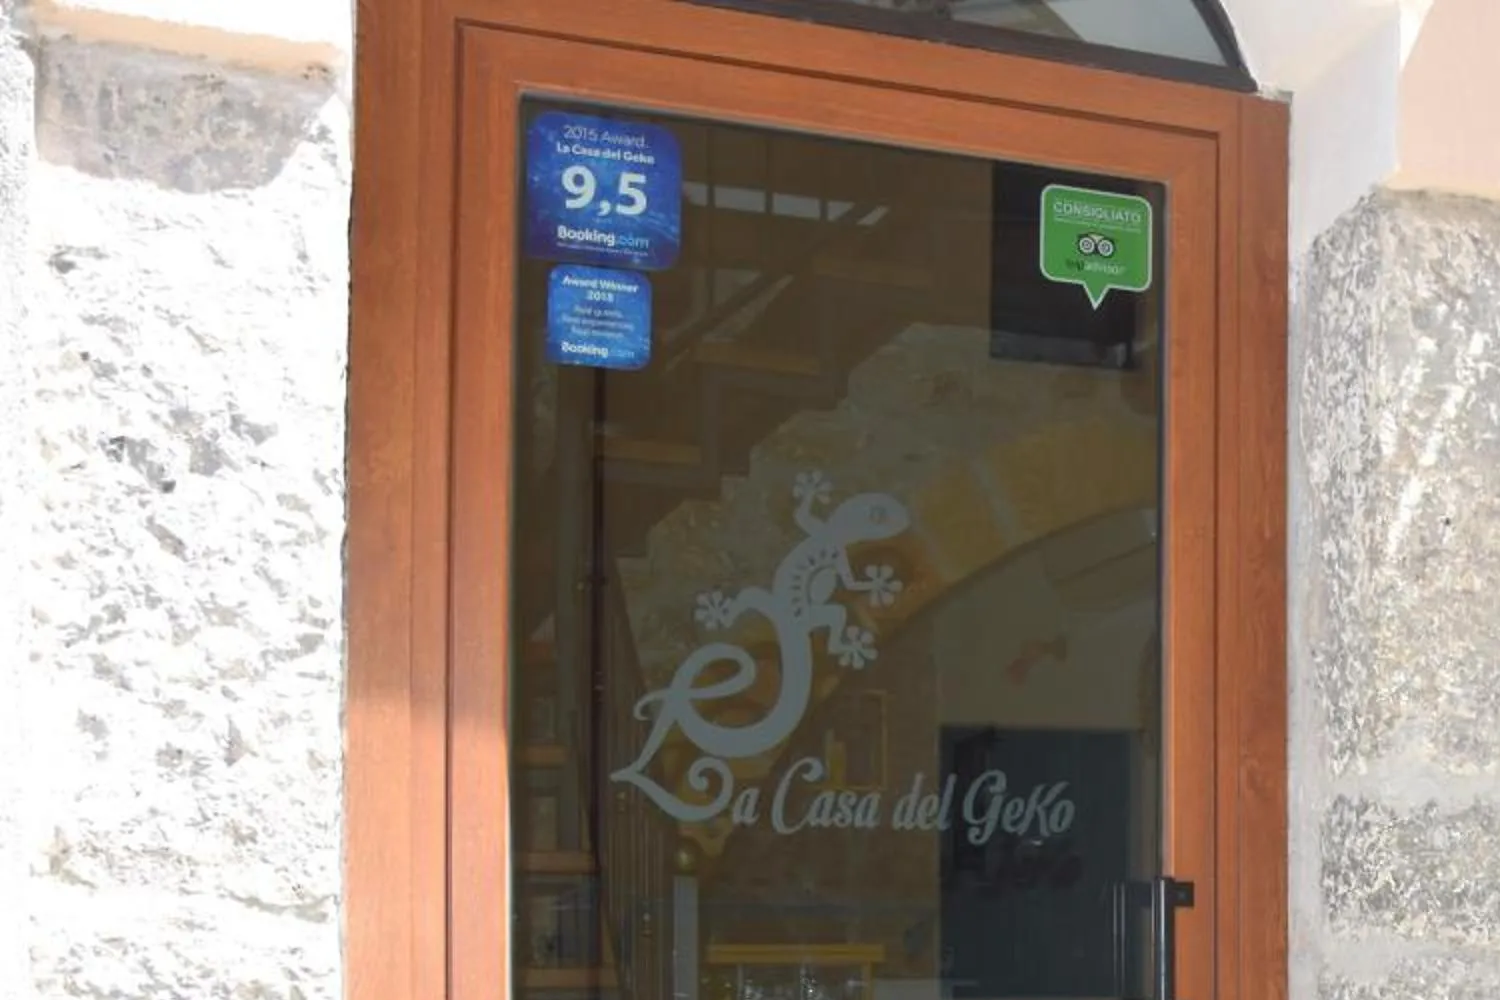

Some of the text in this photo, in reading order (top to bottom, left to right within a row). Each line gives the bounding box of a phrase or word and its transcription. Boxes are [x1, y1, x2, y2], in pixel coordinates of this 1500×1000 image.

[563, 124, 598, 142] 2015
[561, 164, 648, 217] 9,5
[556, 225, 650, 249] Booking.com
[770, 756, 881, 834] Casa
[892, 772, 958, 832] del
